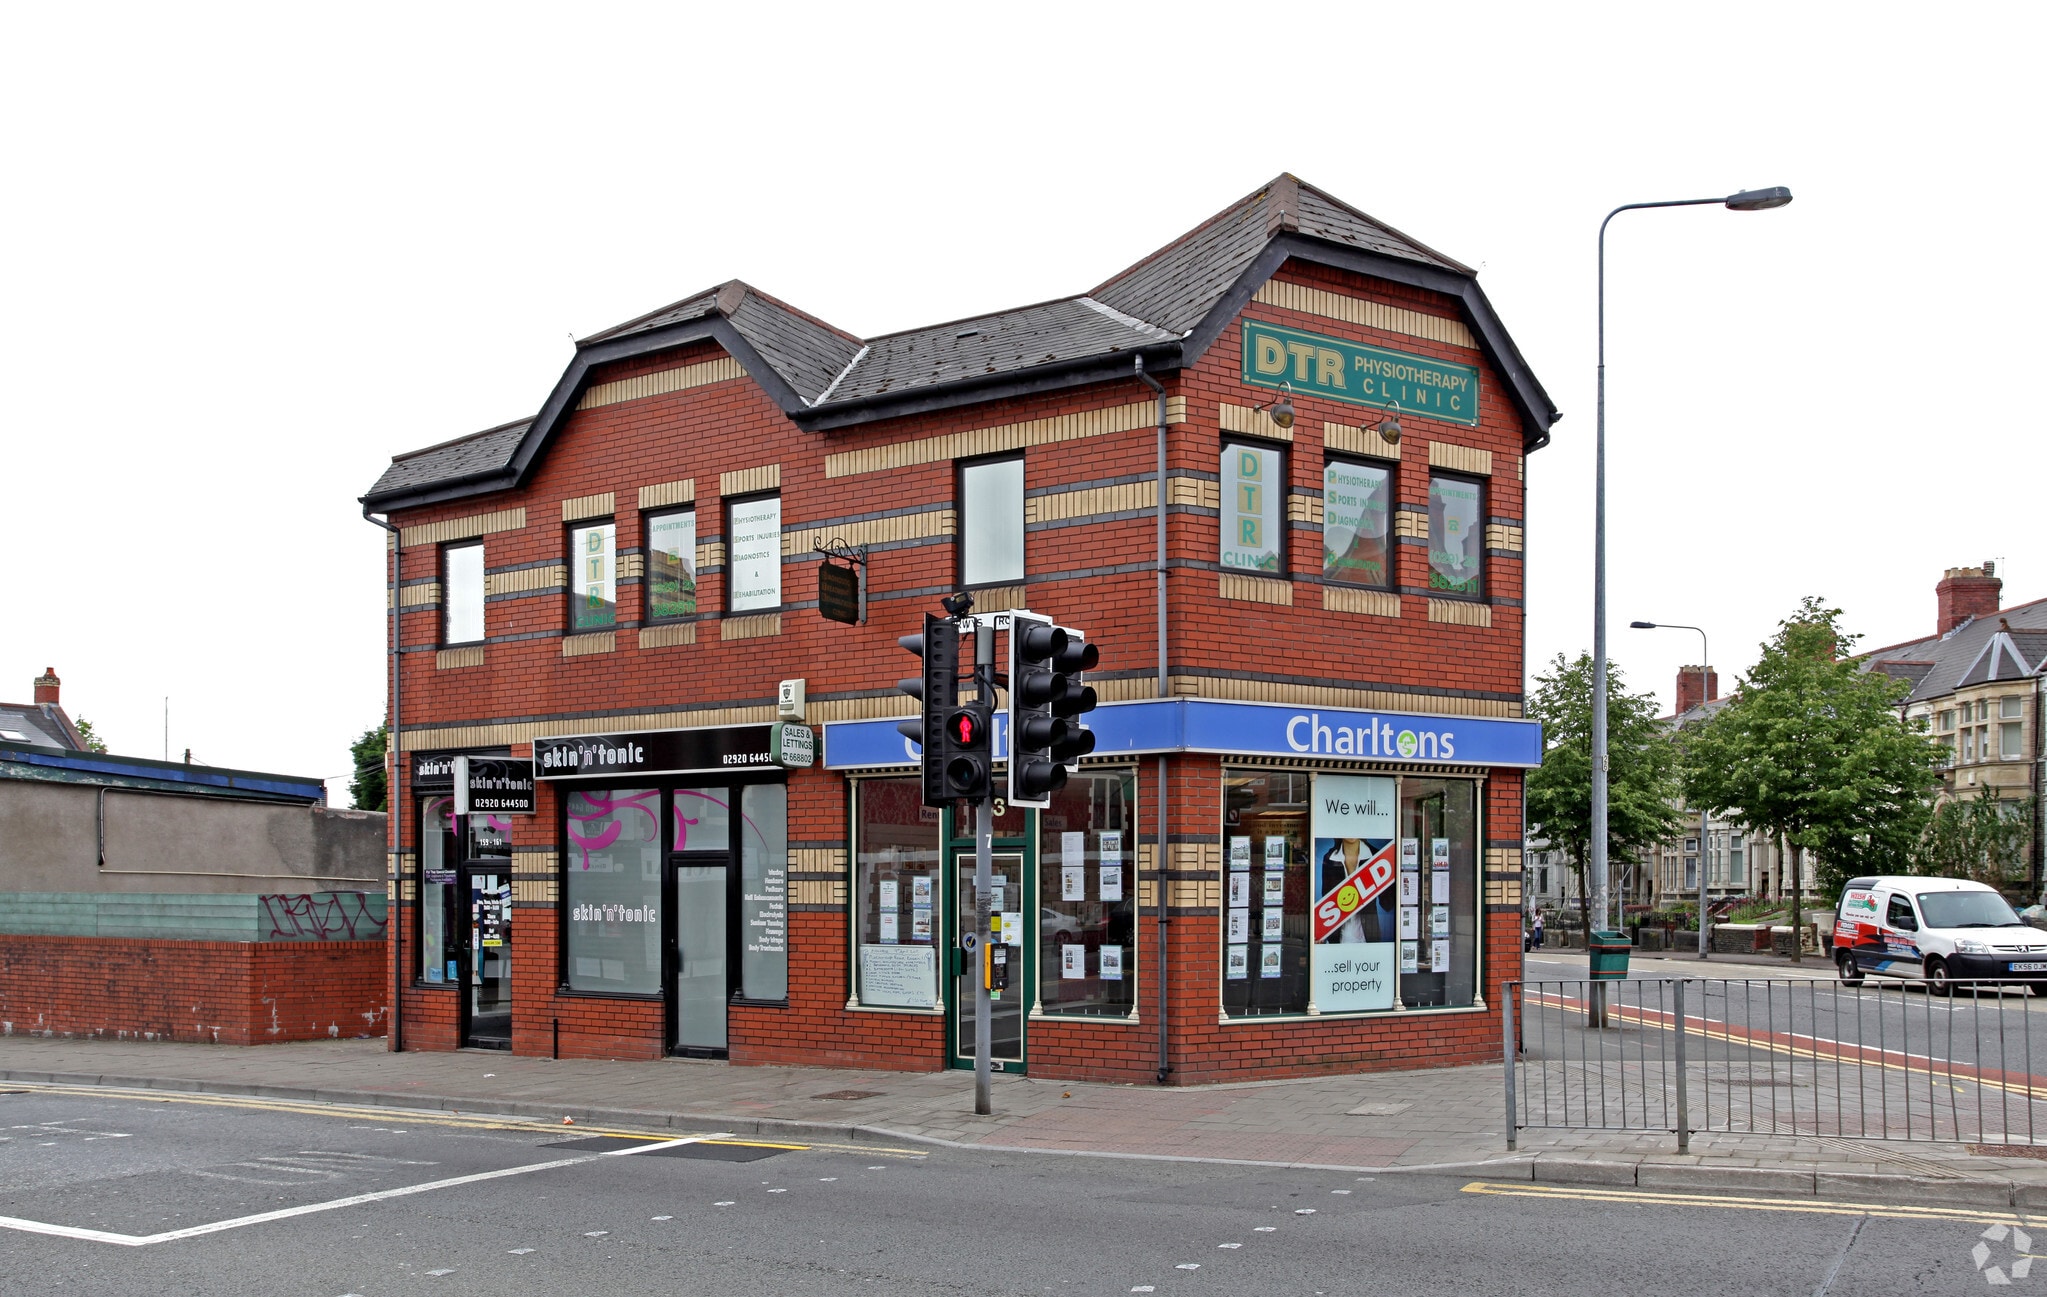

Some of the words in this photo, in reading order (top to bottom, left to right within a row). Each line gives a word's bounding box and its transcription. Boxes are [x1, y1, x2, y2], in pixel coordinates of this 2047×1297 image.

[1255, 334, 1347, 389] DTR
[1355, 356, 1467, 392] PHYSIOTHERAPY
[1363, 379, 1460, 411] CLINIC
[1328, 490, 1357, 507] SPORTS
[653, 520, 695, 532] APPOINTMENTS
[757, 531, 779, 541] INJURIES
[1223, 551, 1276, 570] CLINIC
[577, 612, 616, 627] CLINIC
[784, 727, 805, 739] SALES
[805, 730, 811, 739] &
[1286, 713, 1455, 759] Charltons
[782, 738, 813, 750] LETTINGS
[543, 742, 644, 768] skin'n'tonic
[722, 754, 747, 764] 02920
[789, 752, 812, 763] 668802
[469, 777, 533, 790] skin'n'tonic
[475, 799, 500, 808] 02920
[501, 799, 529, 808] 644500
[1325, 799, 1350, 815] We
[1355, 800, 1388, 816] will...
[921, 810, 940, 820] Ren
[1045, 816, 1062, 827] Sales
[985, 834, 992, 849] 7
[1319, 858, 1392, 927] SOLD
[572, 903, 656, 922] skin'n'tonic
[1324, 960, 1352, 974] ...sell
[1355, 961, 1381, 975] your
[1332, 978, 1382, 994] property
